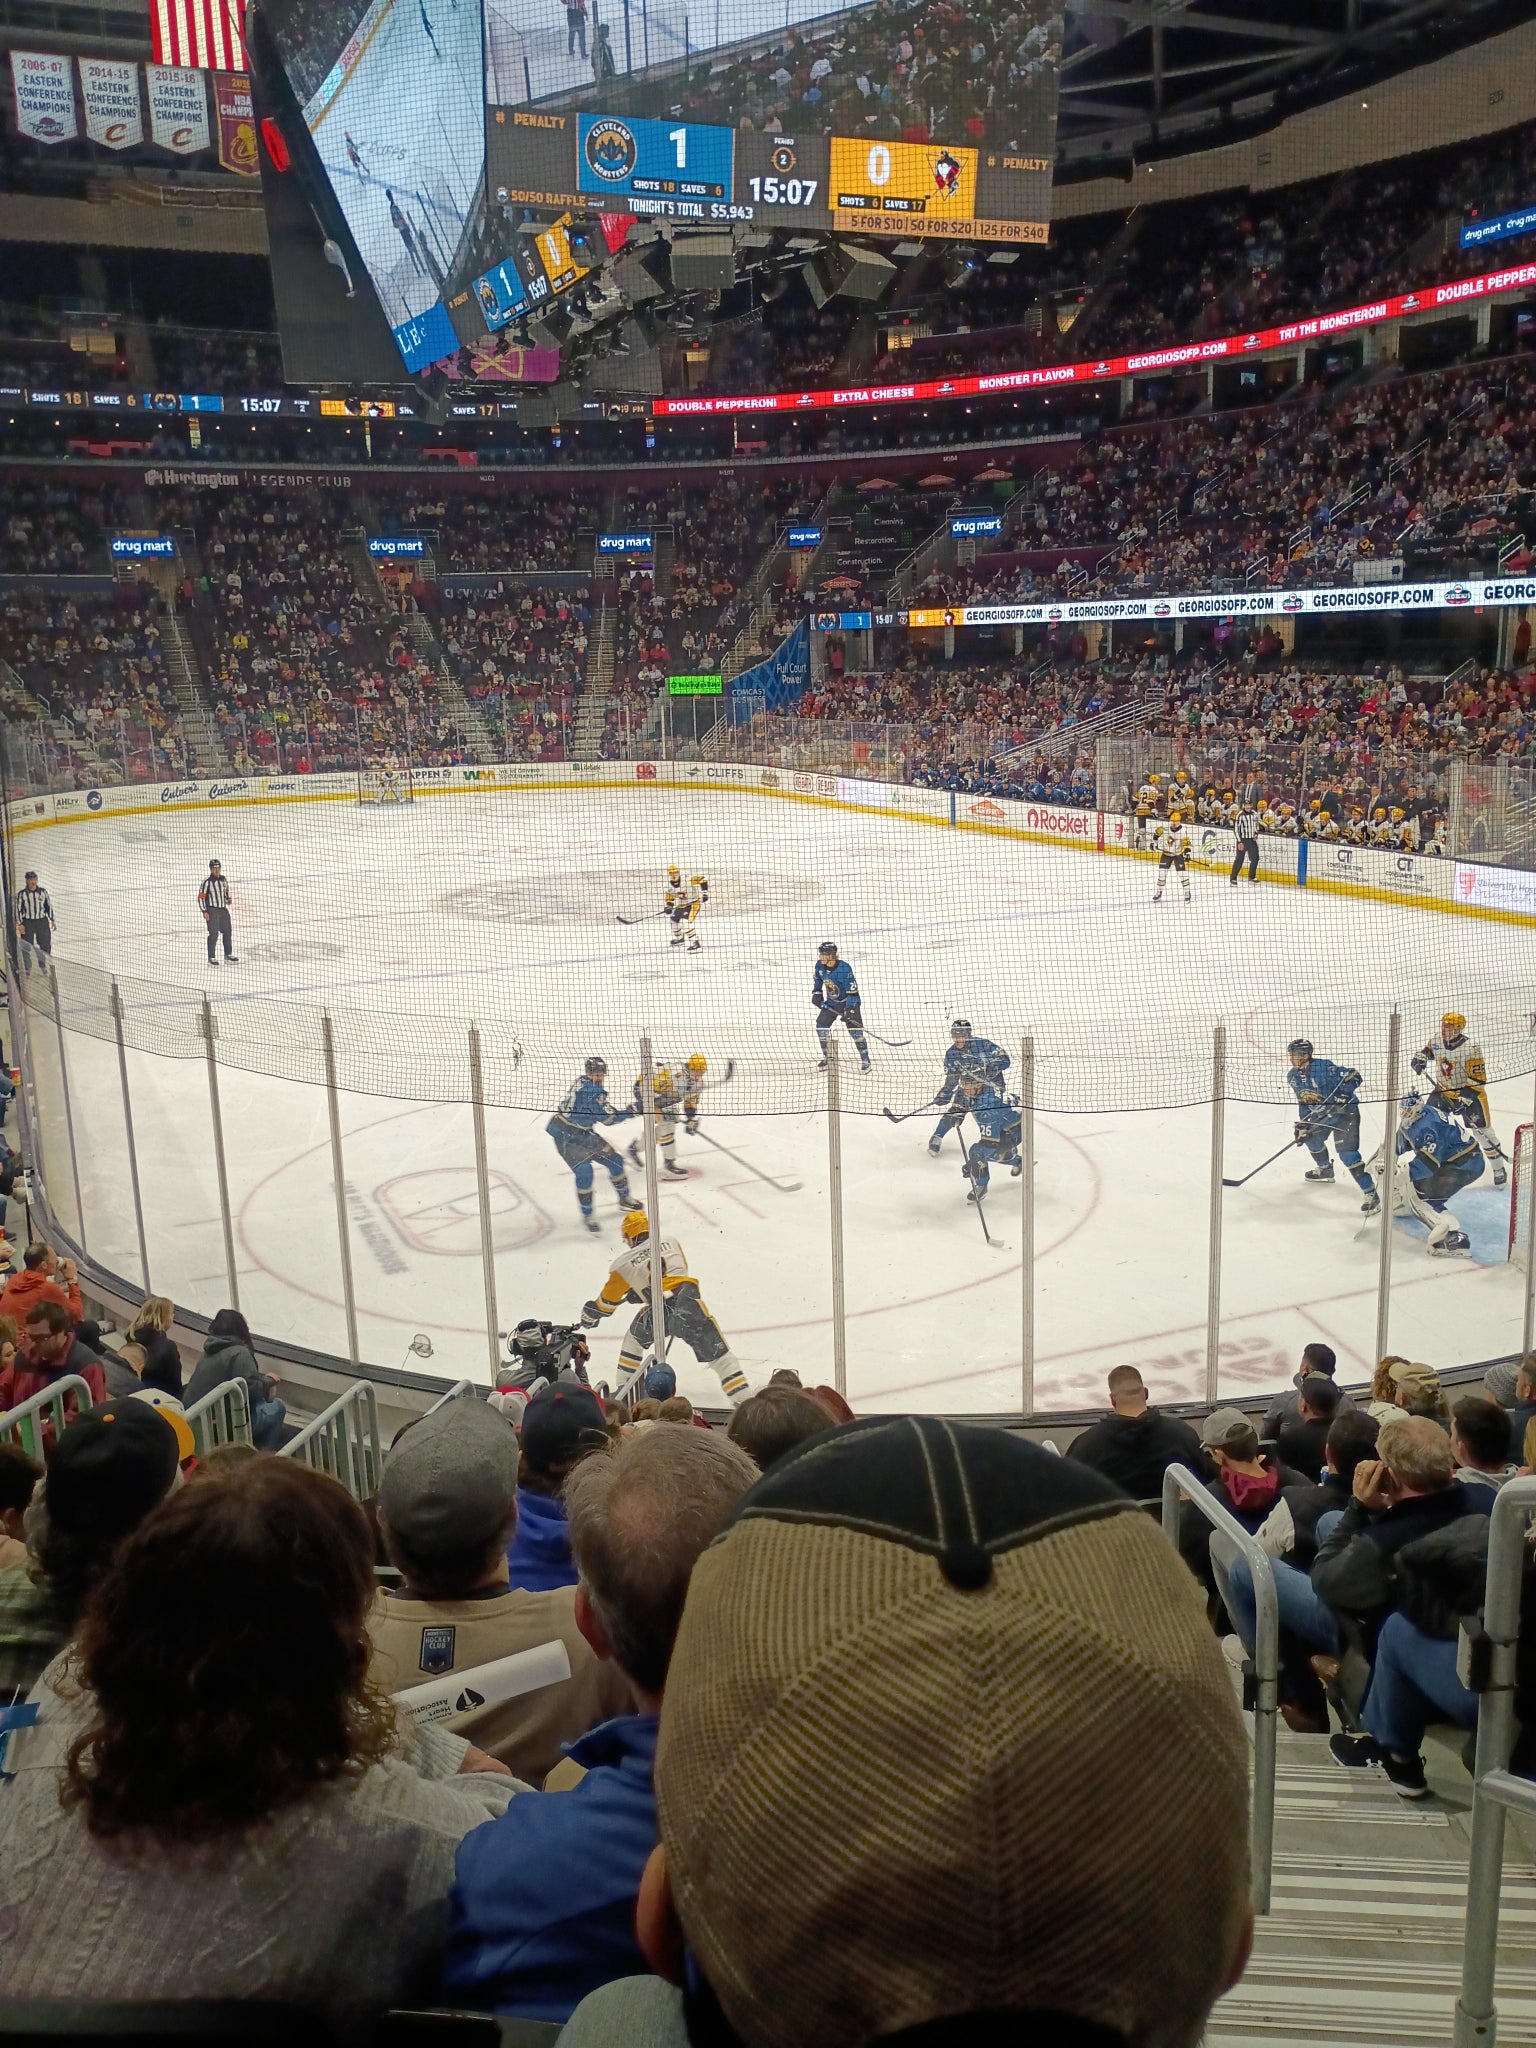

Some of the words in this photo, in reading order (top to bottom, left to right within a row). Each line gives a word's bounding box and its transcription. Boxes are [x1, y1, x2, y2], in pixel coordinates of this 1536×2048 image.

[22, 60, 62, 72] 2006-07
[89, 67, 130, 79] 2014-15
[156, 71, 196, 84] 2015-16
[24, 75, 62, 87] EASTERN
[92, 81, 128, 93] EASTERN
[18, 87, 72, 100] CONFERENCE
[159, 86, 195, 98] EASTERN
[87, 93, 138, 106] CONFERENCE
[153, 98, 203, 110] CONFERENCE
[22, 100, 70, 113] CHAMPIONS
[90, 106, 136, 118] CHAMPIONS
[156, 110, 202, 123] CHAMPIONS
[514, 112, 566, 130] PENALTY
[592, 123, 630, 141] CLEVELAND
[669, 128, 686, 168] 1
[774, 138, 794, 146] PERIOD
[780, 155, 787, 164] 2
[867, 145, 892, 186] 0
[1003, 158, 1048, 171] PENALTY
[593, 161, 629, 178] MONSTERS
[634, 180, 660, 191] SHOTS
[662, 182, 675, 192] 18
[680, 185, 706, 194] SAVES
[716, 186, 722, 196] 6
[750, 177, 818, 206] 15:07
[511, 190, 544, 204] 50/50
[546, 192, 586, 208] RAFFLE
[840, 196, 865, 206] SHOTS
[872, 198, 879, 208] 6
[628, 198, 674, 214] TONIGHT'S
[676, 202, 704, 217] TOTAL
[710, 202, 754, 220] $5,943
[884, 200, 908, 210] SAVES
[912, 200, 923, 212] 17
[851, 215, 860, 227] 5
[860, 216, 882, 229] FOR
[884, 216, 904, 230] $10
[910, 219, 924, 232] 50
[926, 220, 948, 234] FOR
[951, 222, 972, 235] $20
[980, 222, 998, 236] 125
[1000, 224, 1020, 237] FOR
[1024, 225, 1044, 239] $40
[1465, 230, 1482, 240] drug
[1482, 223, 1501, 236] mart
[1506, 217, 1524, 228] drug
[500, 266, 513, 297] 1
[528, 275, 548, 300] 15:07
[1436, 280, 1484, 303] DOUBLE
[1279, 326, 1296, 341] TRY
[1300, 322, 1318, 336] THE
[1320, 304, 1386, 331] MONSTERONI
[1128, 342, 1228, 370] GEORGIOSOFP.COM
[979, 374, 1030, 389] MONSTER
[1032, 368, 1074, 384] FLAVOR
[32, 392, 60, 402] SHOTS
[64, 392, 82, 405] 18
[94, 394, 120, 405] SAVES
[127, 394, 136, 407] 6
[834, 391, 869, 402] EXTRA
[872, 388, 914, 400] CHEESE
[191, 396, 200, 409] 1
[240, 398, 281, 413] 15:07
[668, 401, 712, 412] DOUBLE
[716, 398, 777, 410] PEPPERONI
[452, 406, 476, 415] SAVES
[479, 406, 494, 416] 17
[952, 521, 976, 534] drug
[976, 519, 1002, 531] mart
[113, 540, 142, 554] drug
[144, 540, 173, 551] mart
[370, 541, 395, 554] drug
[398, 542, 423, 551] mart
[600, 538, 624, 550] drug
[626, 538, 652, 546] mart
[1313, 589, 1434, 608] GEORGIOSOFP.COM
[1068, 604, 1147, 618] GEORGIOSOFP.COM
[1178, 598, 1274, 613] GEORGIOSOFP.COM
[966, 608, 1044, 622] GEORGIOSOFP.COM
[776, 663, 788, 674] Full
[790, 663, 807, 674] Court
[782, 675, 802, 684] Power
[732, 688, 766, 696] COMCAST
[706, 767, 744, 780] CLIFFS
[161, 782, 200, 802] Culver's
[208, 780, 248, 800] Culver's
[1040, 810, 1088, 836] Rocket
[980, 1124, 992, 1137] 26
[426, 1636, 452, 1644] HOCKEY
[429, 1642, 446, 1650] CLUB
[405, 1698, 448, 1716] Association
[428, 1706, 451, 1717] Heart
